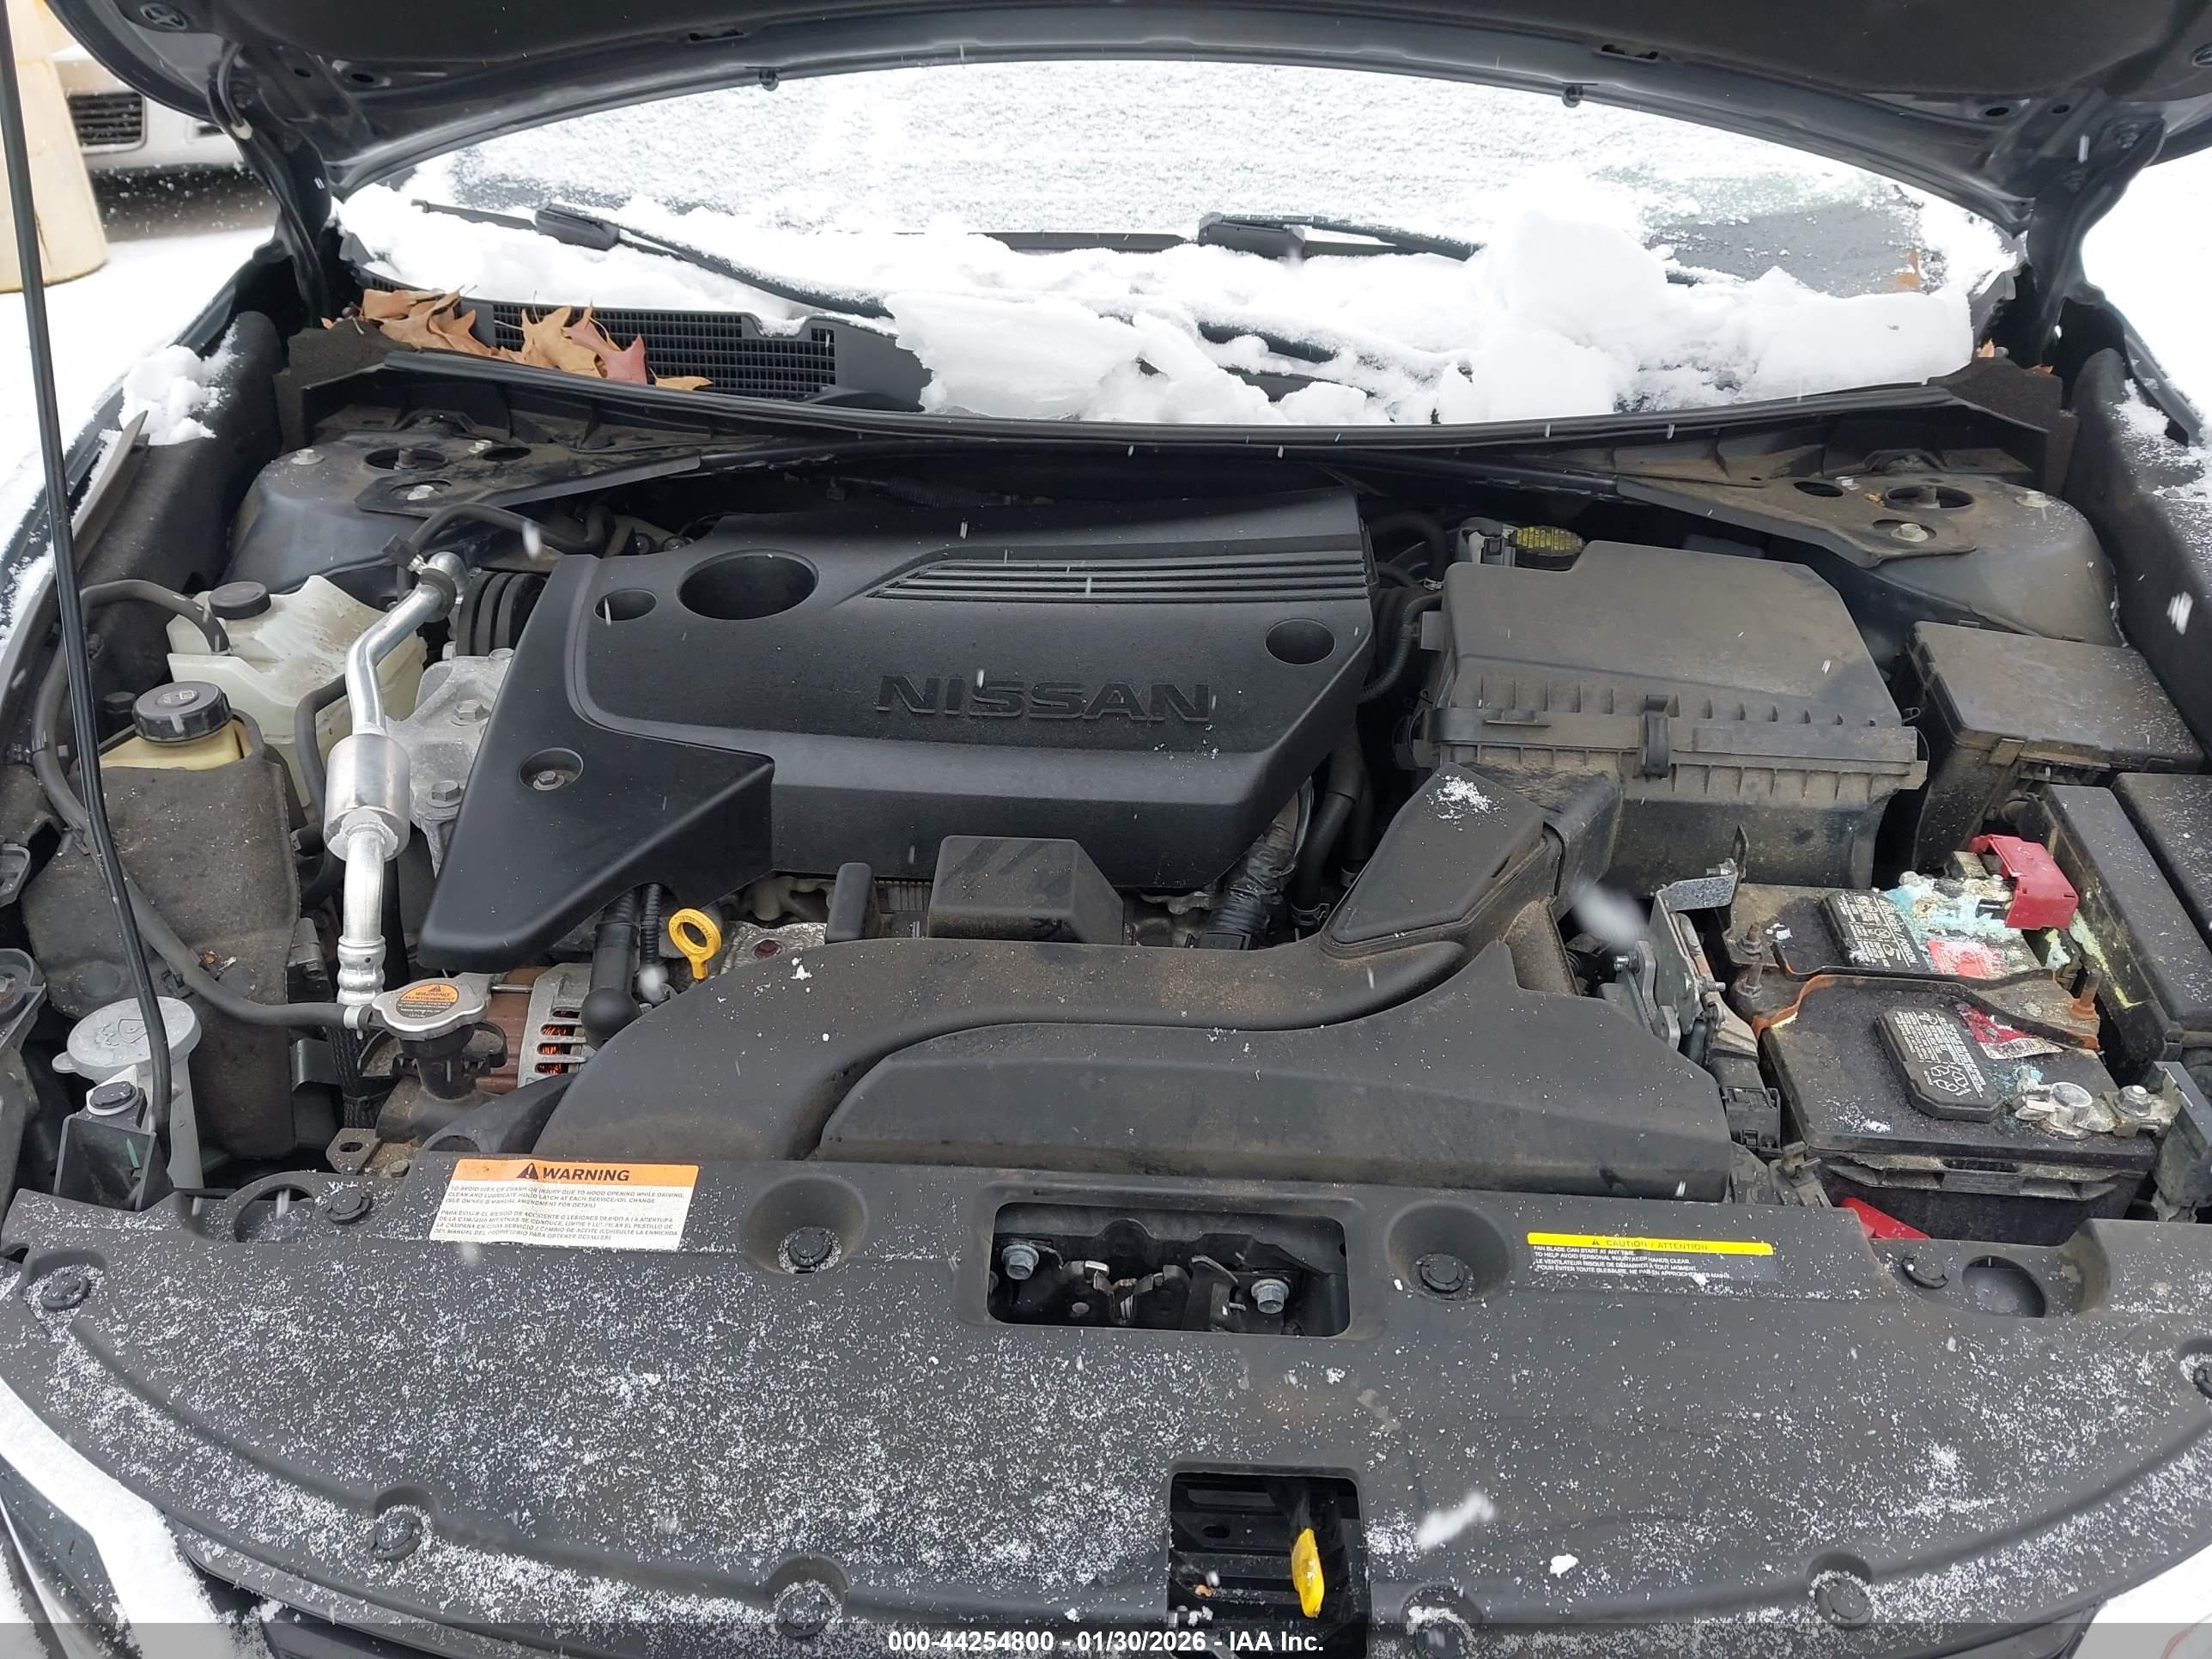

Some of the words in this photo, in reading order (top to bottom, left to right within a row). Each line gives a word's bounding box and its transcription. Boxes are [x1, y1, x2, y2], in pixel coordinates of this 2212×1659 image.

[876, 676, 1210, 721] NISSAN
[1881, 904, 1902, 935] DANGER
[1899, 938, 1919, 963] POISON
[543, 1167, 630, 1182] WARNING
[1606, 1239, 1648, 1248] CAUTION
